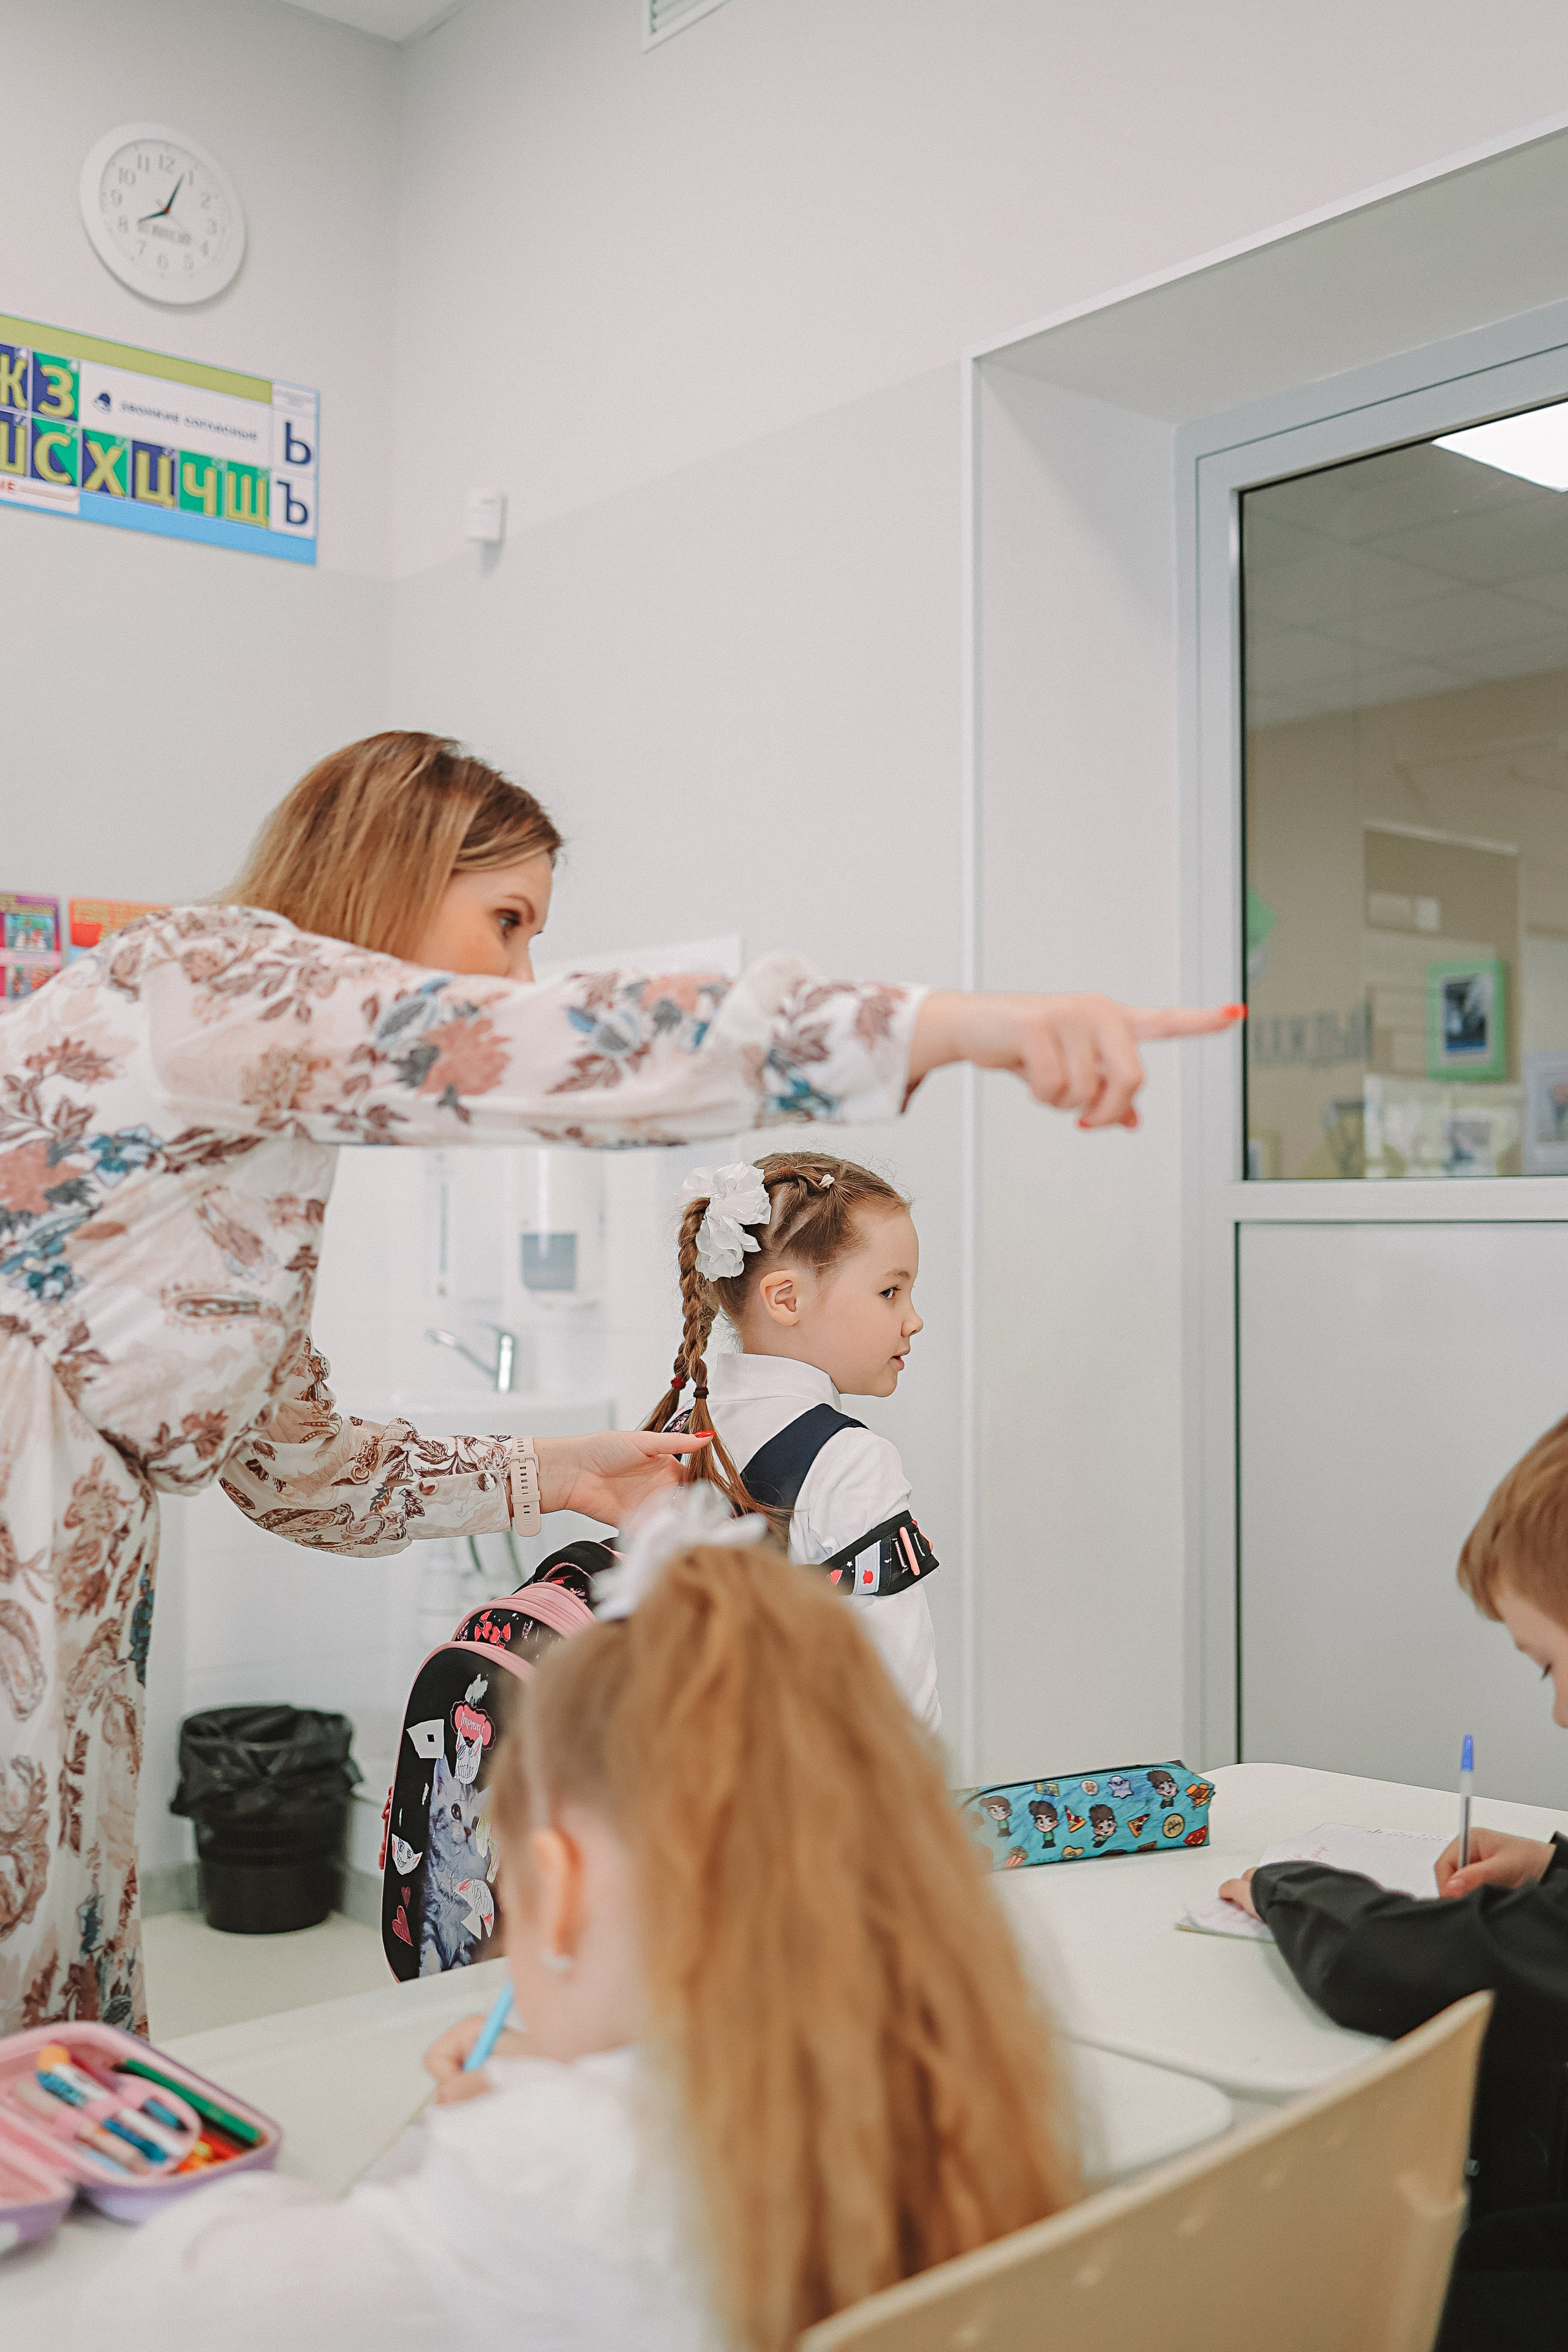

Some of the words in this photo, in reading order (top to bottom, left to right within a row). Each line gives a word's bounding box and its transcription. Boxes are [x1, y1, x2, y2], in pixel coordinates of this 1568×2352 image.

[137, 154, 150, 172] 11
[159, 154, 175, 174] 12
[119, 167, 136, 186] 10
[189, 170, 194, 186] 1
[110, 189, 123, 206] 9
[37, 364, 75, 418] З
[285, 420, 311, 464] Ь
[34, 431, 72, 484] С
[84, 441, 124, 497] Х
[136, 450, 175, 508] Ц
[183, 462, 216, 517] Ч
[277, 480, 309, 524] Ъ
